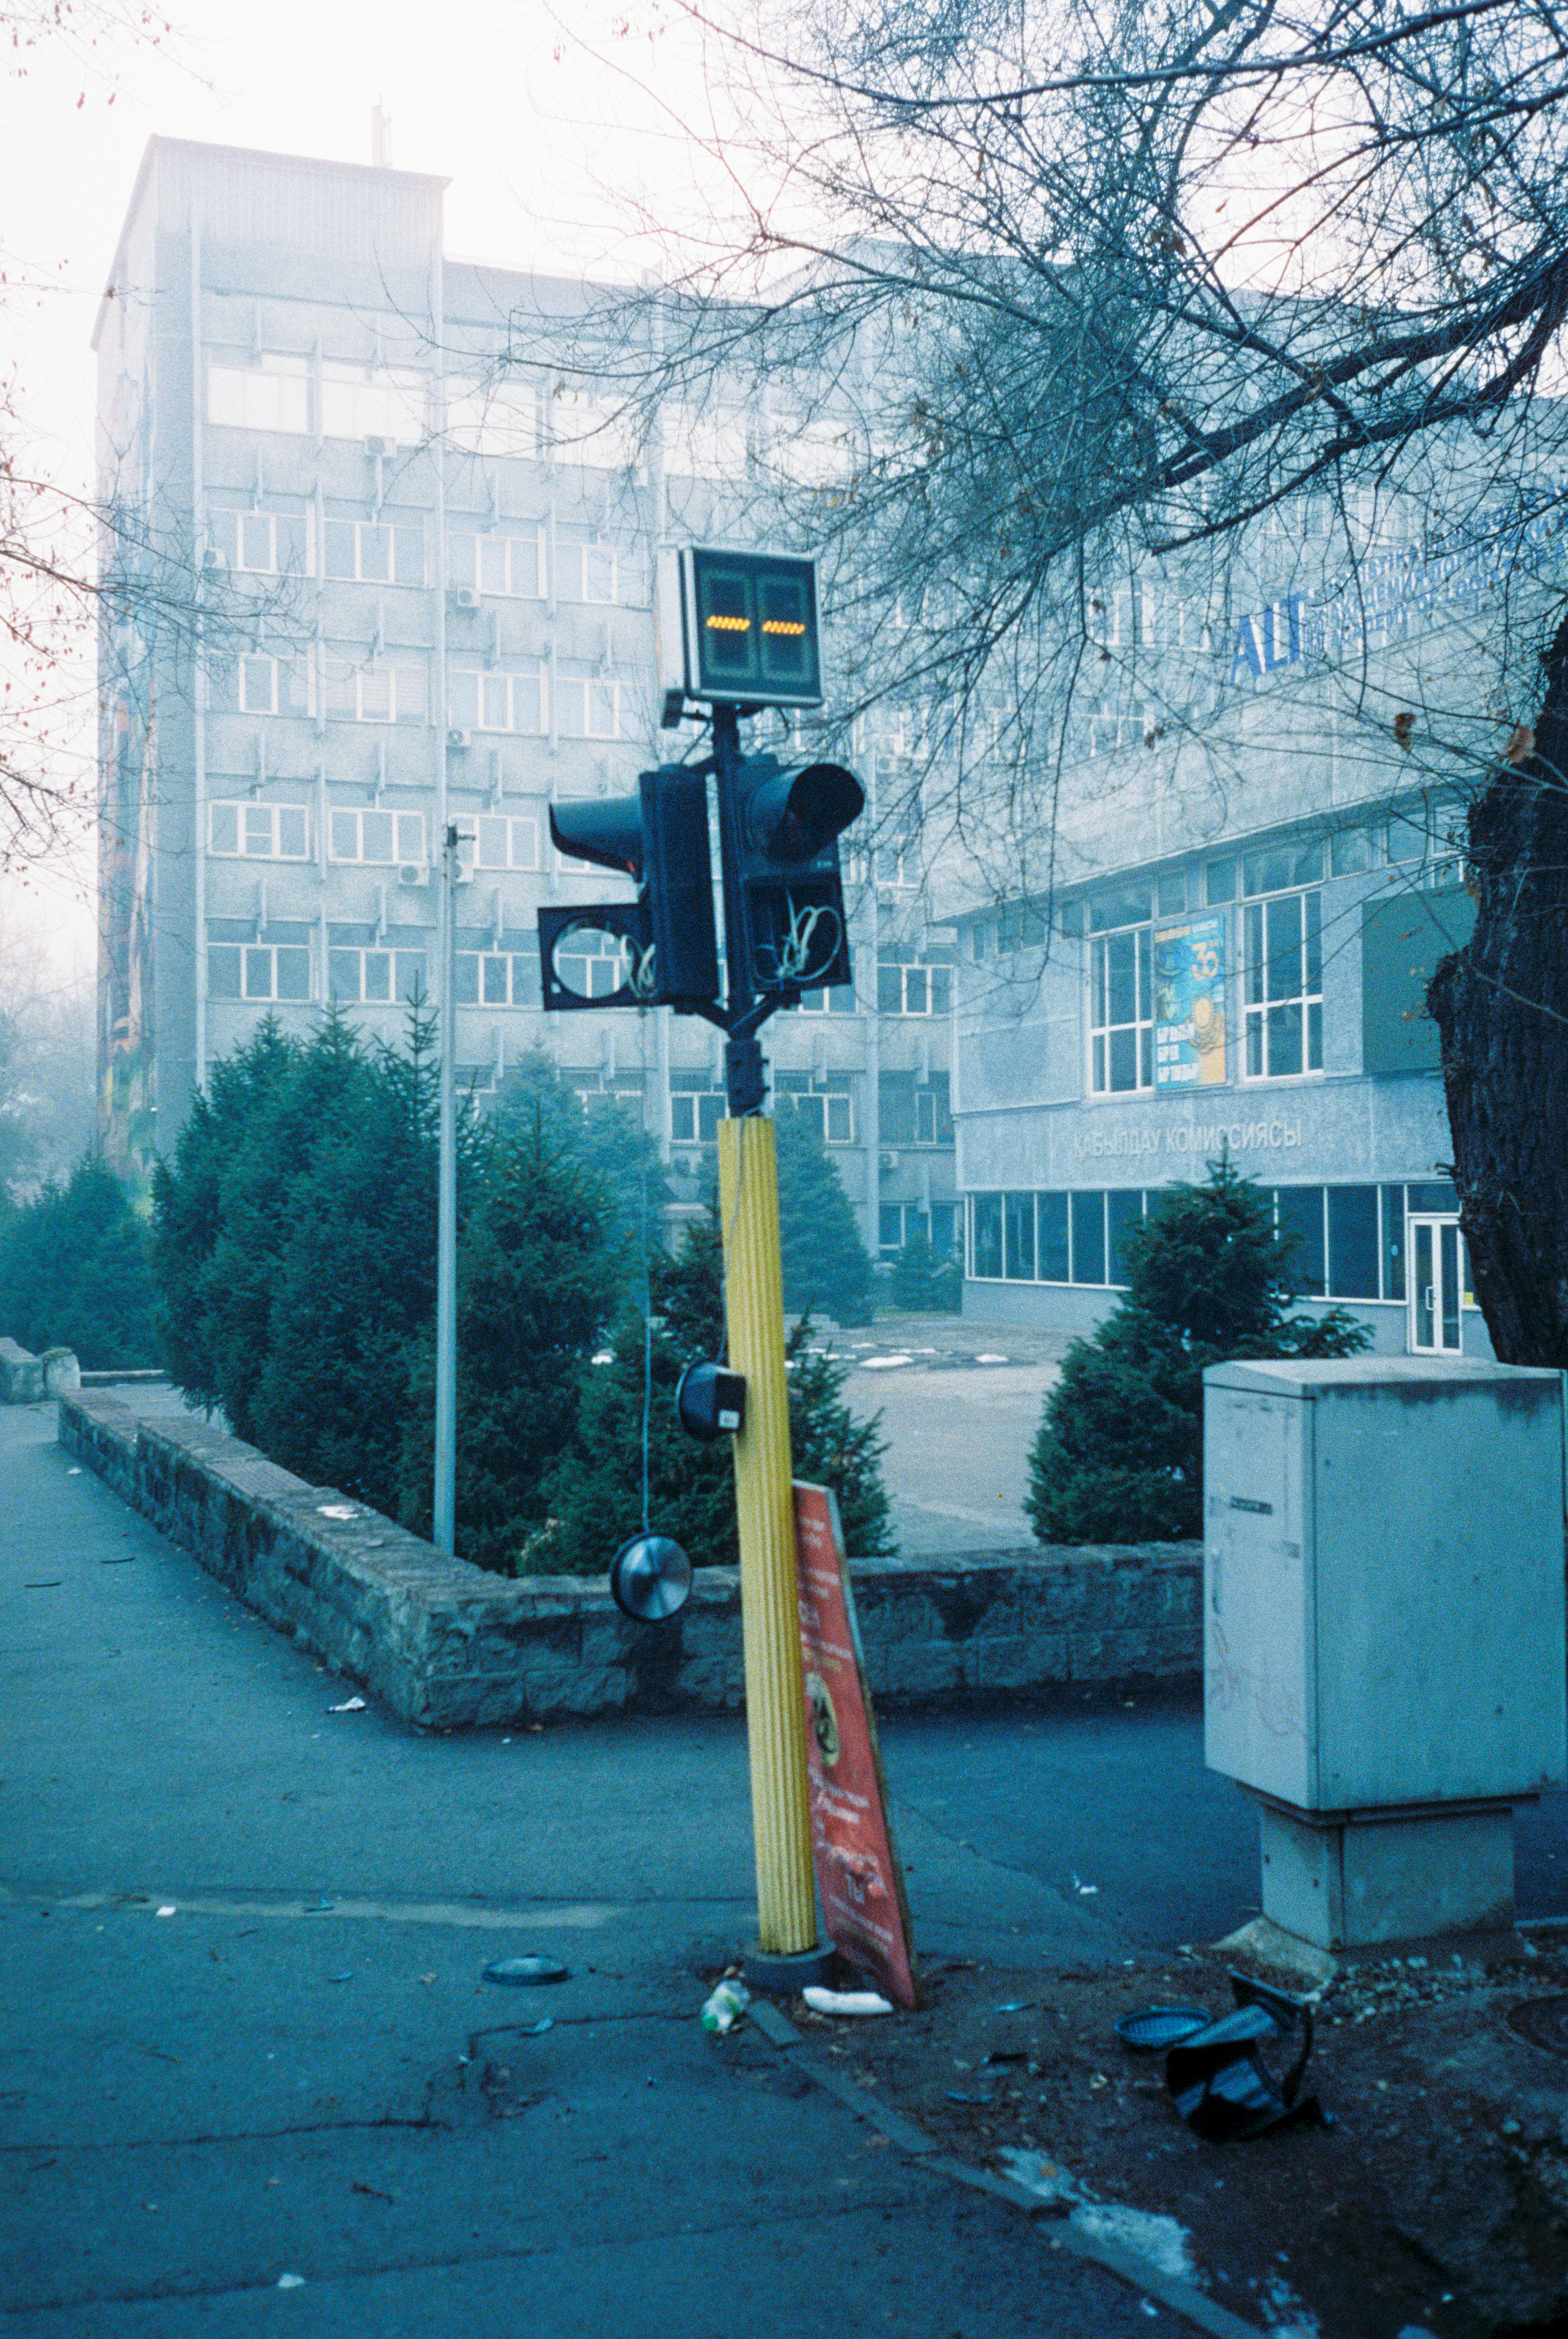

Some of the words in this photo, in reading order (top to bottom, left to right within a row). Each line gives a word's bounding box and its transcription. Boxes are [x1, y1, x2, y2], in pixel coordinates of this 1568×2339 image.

[1444, 548, 1547, 604] LOGISTCS
[1231, 590, 1303, 687] ALT
[1166, 1120, 1302, 1153] КОМИССИЯСЫ
